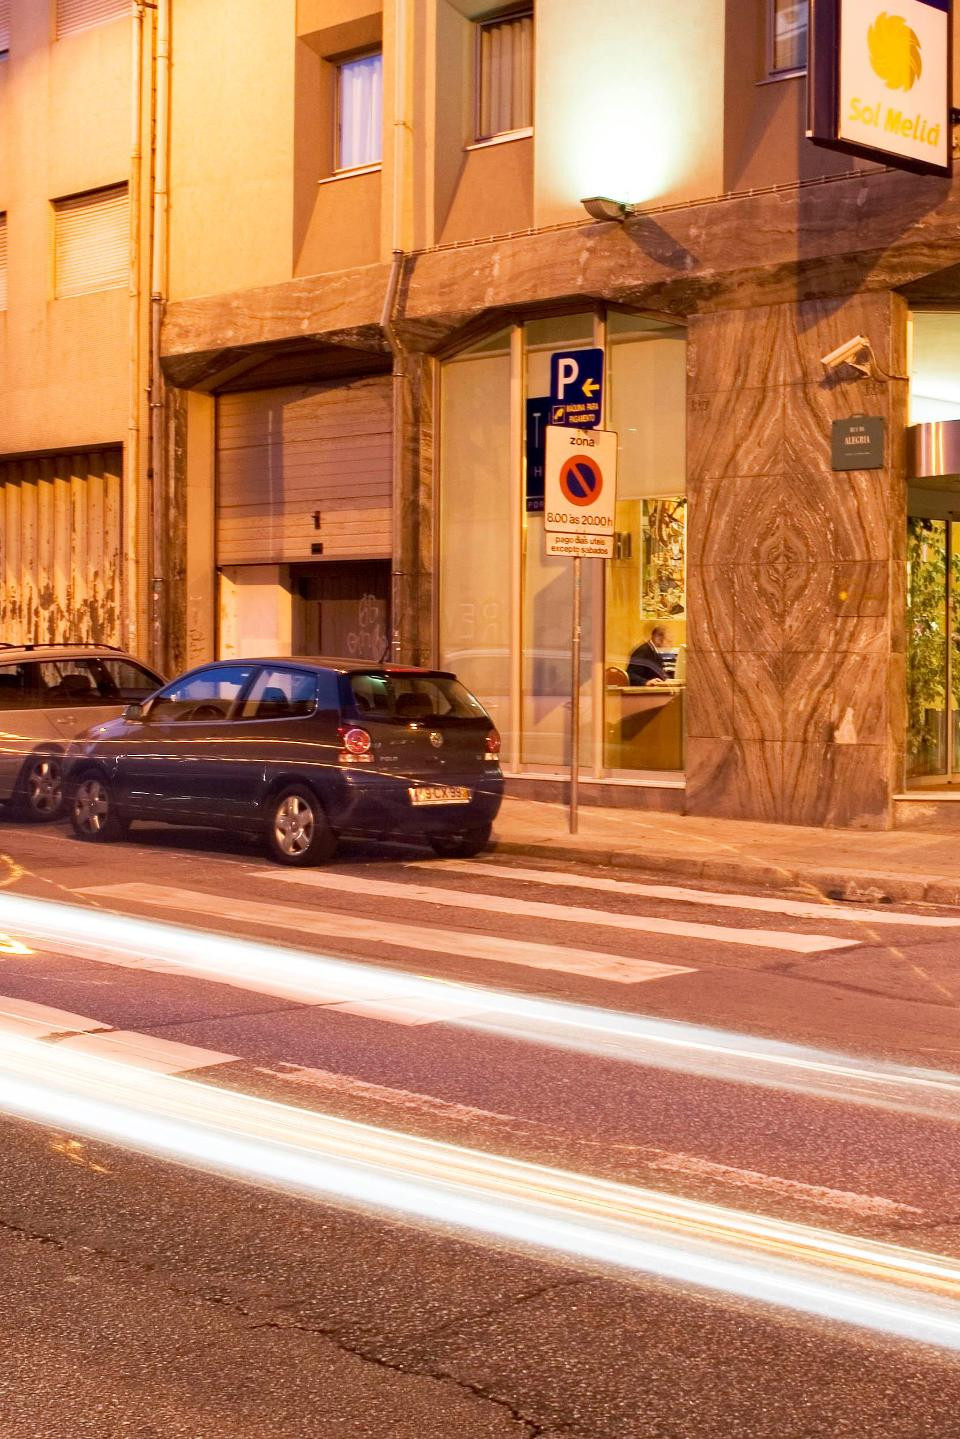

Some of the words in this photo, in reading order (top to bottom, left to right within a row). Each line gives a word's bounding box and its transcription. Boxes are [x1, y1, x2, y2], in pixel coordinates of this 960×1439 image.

[848, 97, 882, 129] Sol
[557, 358, 579, 400] P
[570, 437, 595, 447] zona
[547, 513, 568, 523] 8.00
